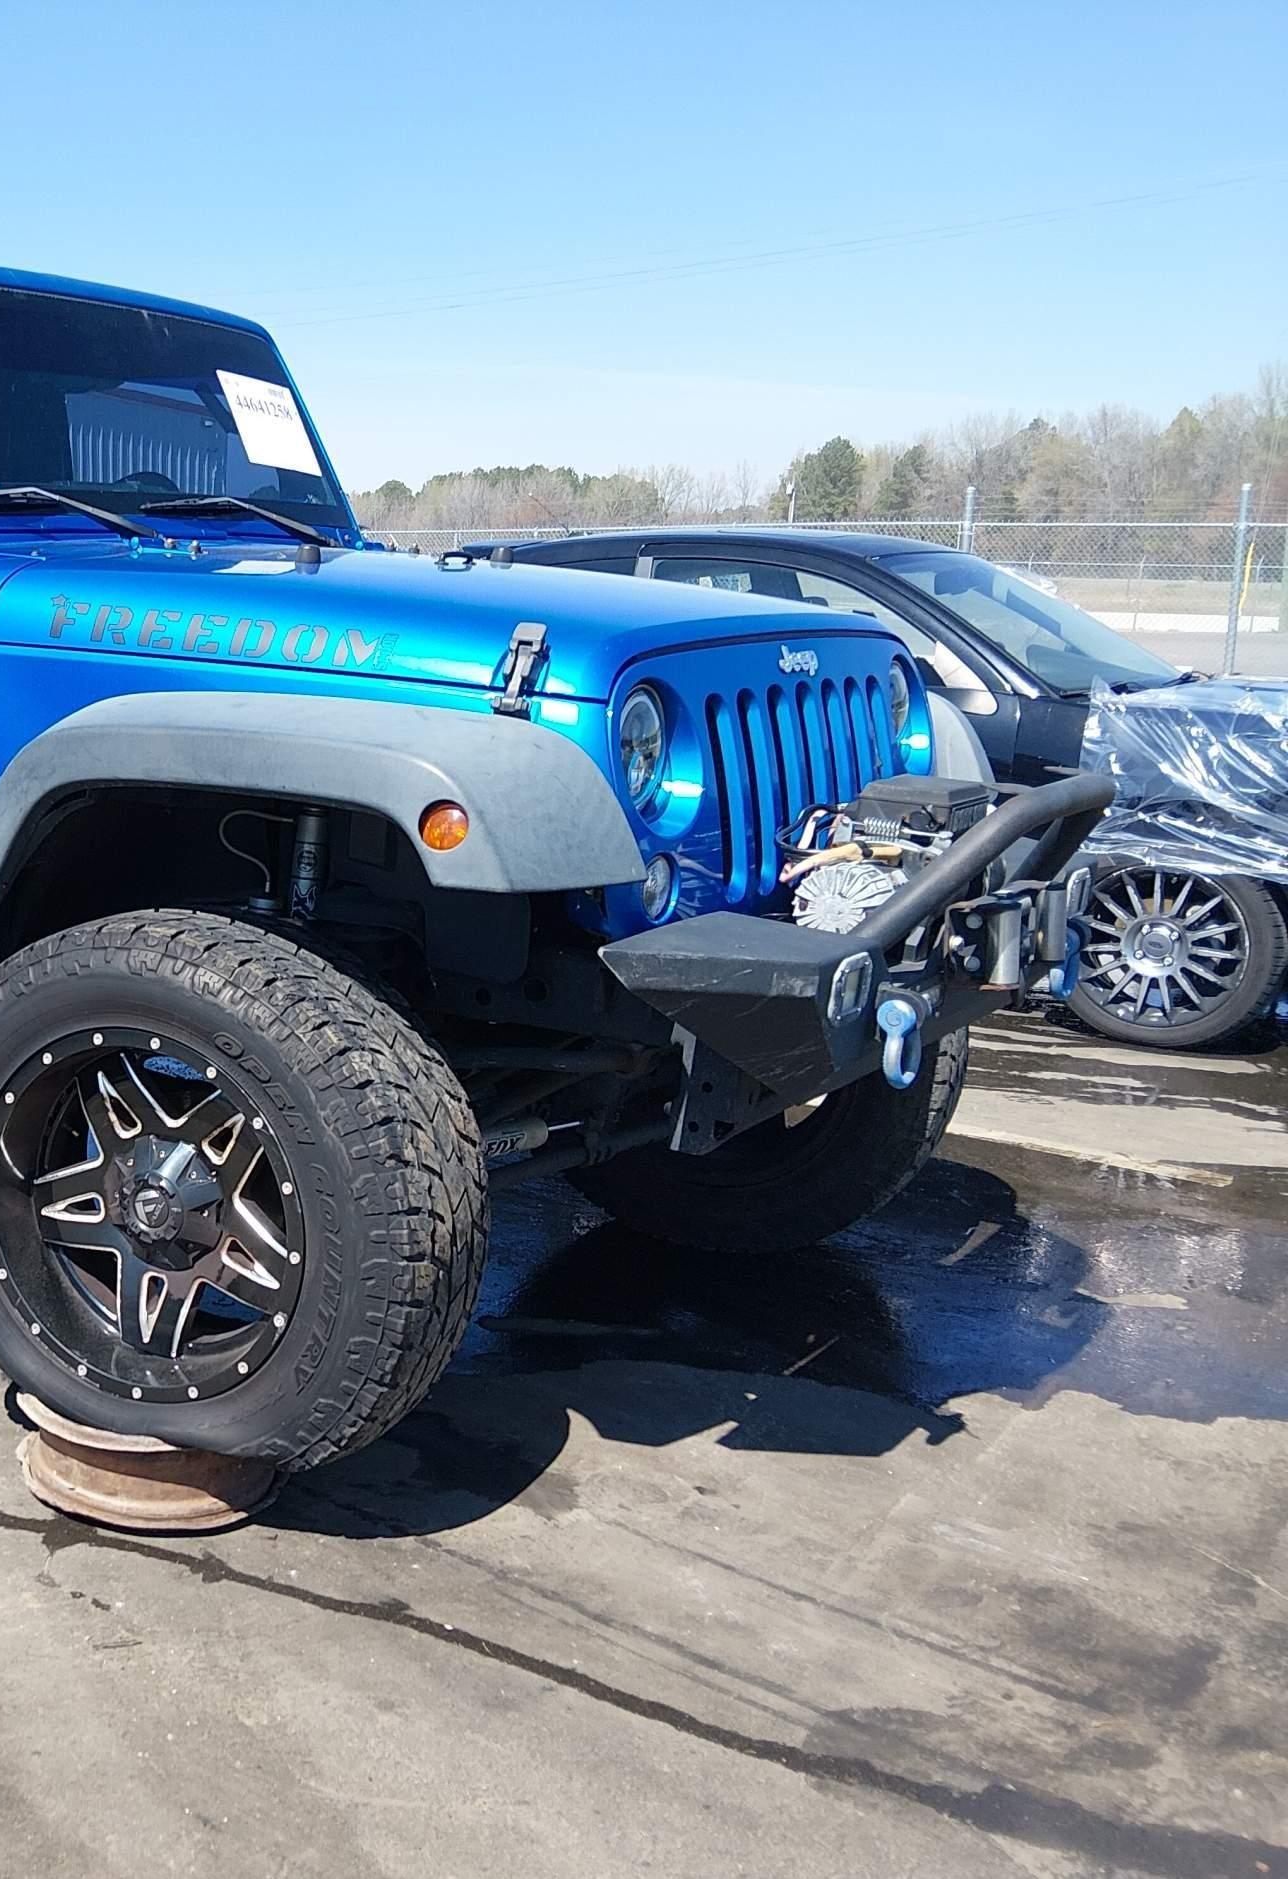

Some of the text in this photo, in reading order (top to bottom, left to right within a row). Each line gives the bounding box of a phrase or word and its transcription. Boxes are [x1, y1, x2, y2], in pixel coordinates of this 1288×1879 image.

[49, 596, 380, 667] FREEDOM
[779, 644, 819, 676] Jeep
[212, 1031, 343, 1396] OPEN COUNTRY
